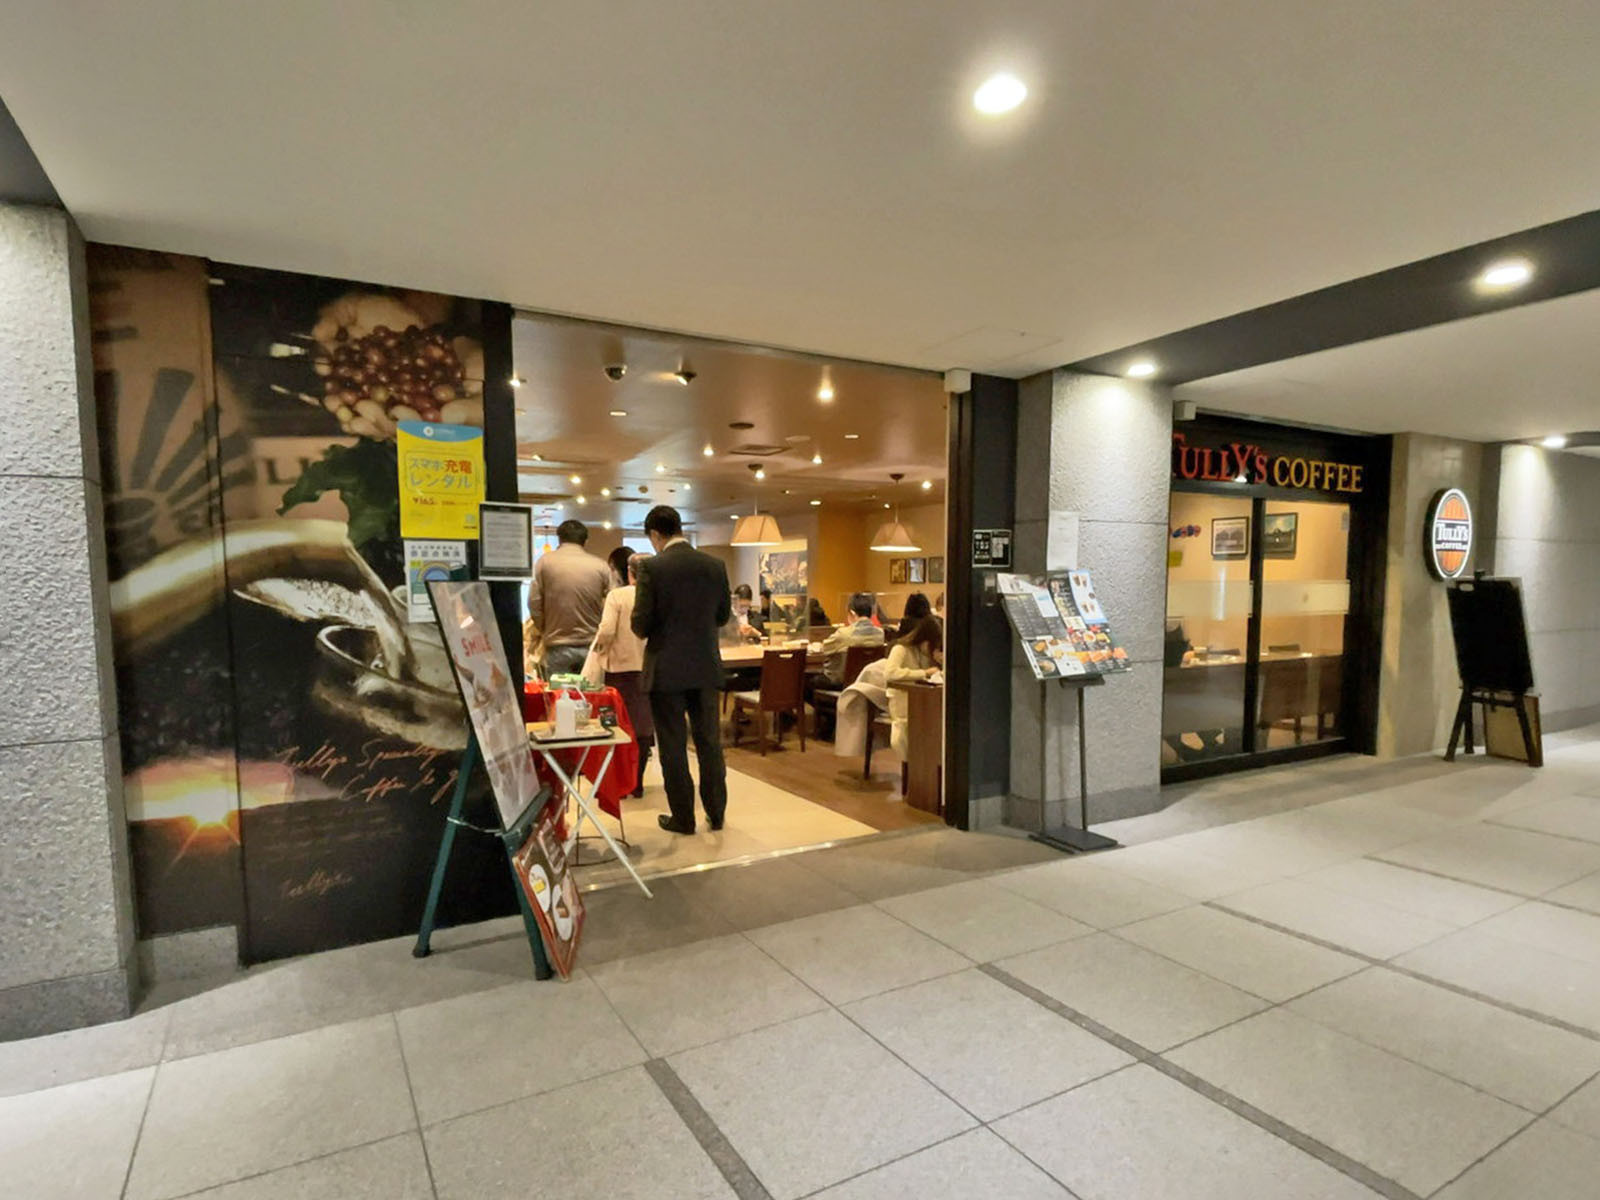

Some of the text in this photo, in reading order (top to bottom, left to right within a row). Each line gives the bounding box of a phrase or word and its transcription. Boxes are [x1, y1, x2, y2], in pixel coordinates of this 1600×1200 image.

[409, 472, 473, 489] レンタル
[1273, 456, 1364, 493] COFFEE
